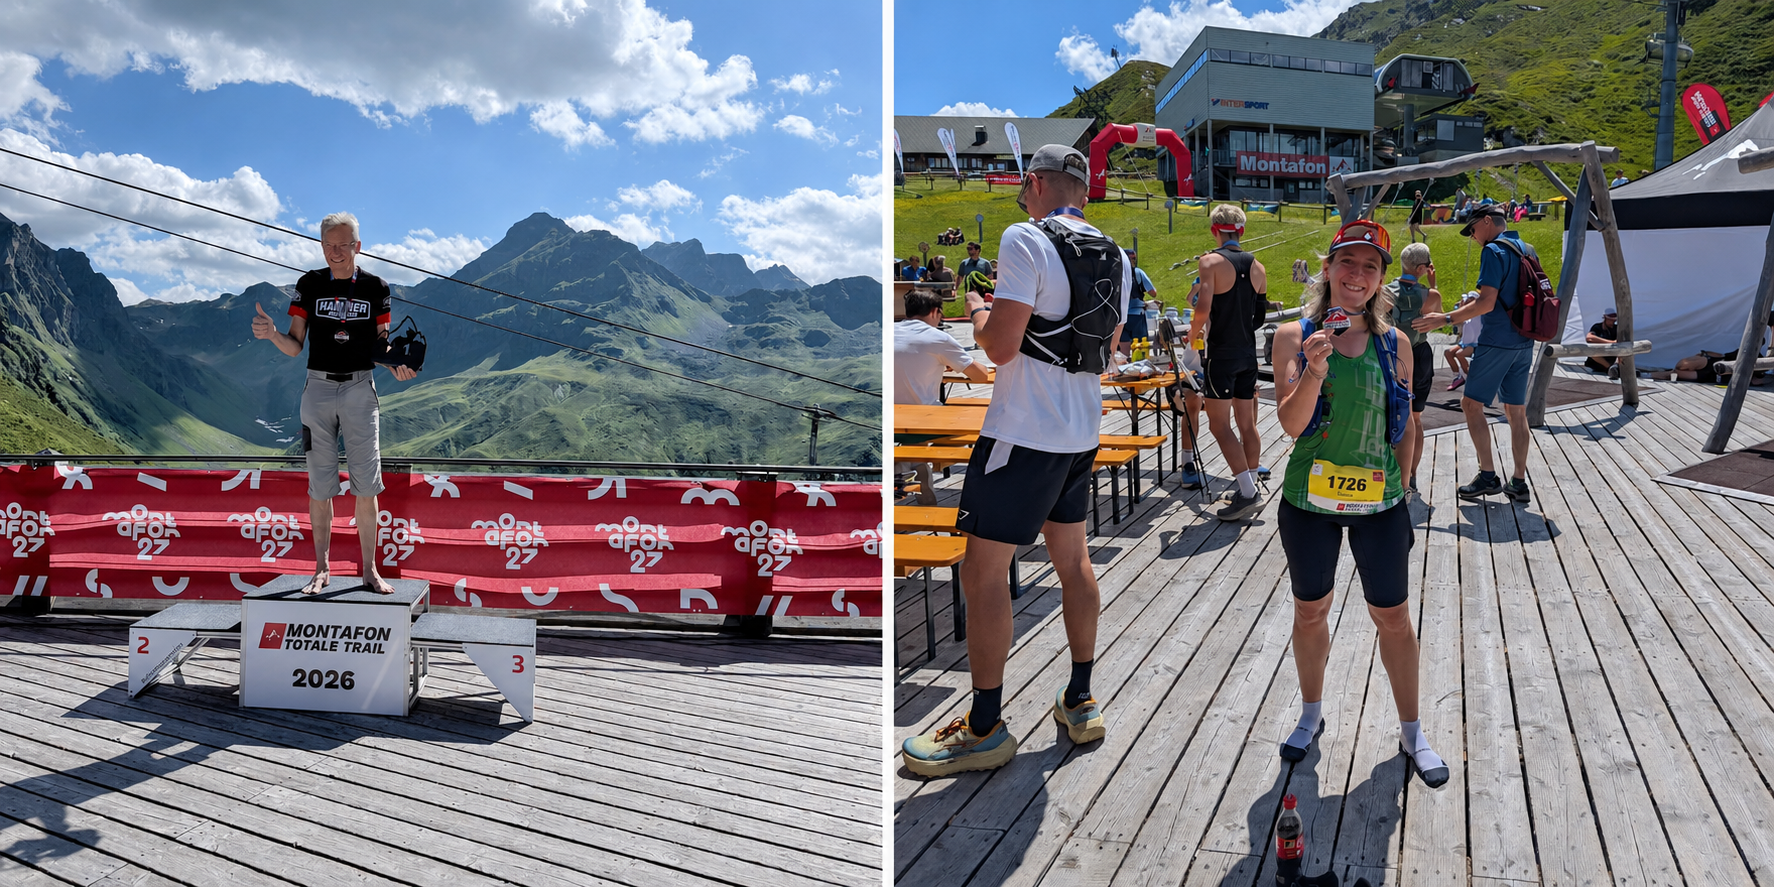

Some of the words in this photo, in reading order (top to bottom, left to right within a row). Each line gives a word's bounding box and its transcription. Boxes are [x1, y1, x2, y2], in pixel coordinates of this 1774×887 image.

[1220, 98, 1270, 110] INTERSPORT
[1240, 155, 1327, 174] Montafon
[1327, 475, 1367, 492] 1726
[12, 536, 45, 558] 27
[137, 537, 170, 560] 27
[261, 540, 293, 562] 27
[382, 543, 415, 566] 27
[505, 547, 538, 570] 27
[630, 549, 663, 573] 27
[757, 553, 792, 577] 27
[286, 623, 391, 641] MONTAFON
[137, 636, 149, 654] 2
[285, 639, 338, 652] TOTALE
[344, 641, 385, 654] TRAIL
[512, 654, 525, 674] 3
[292, 668, 355, 690] 2026
